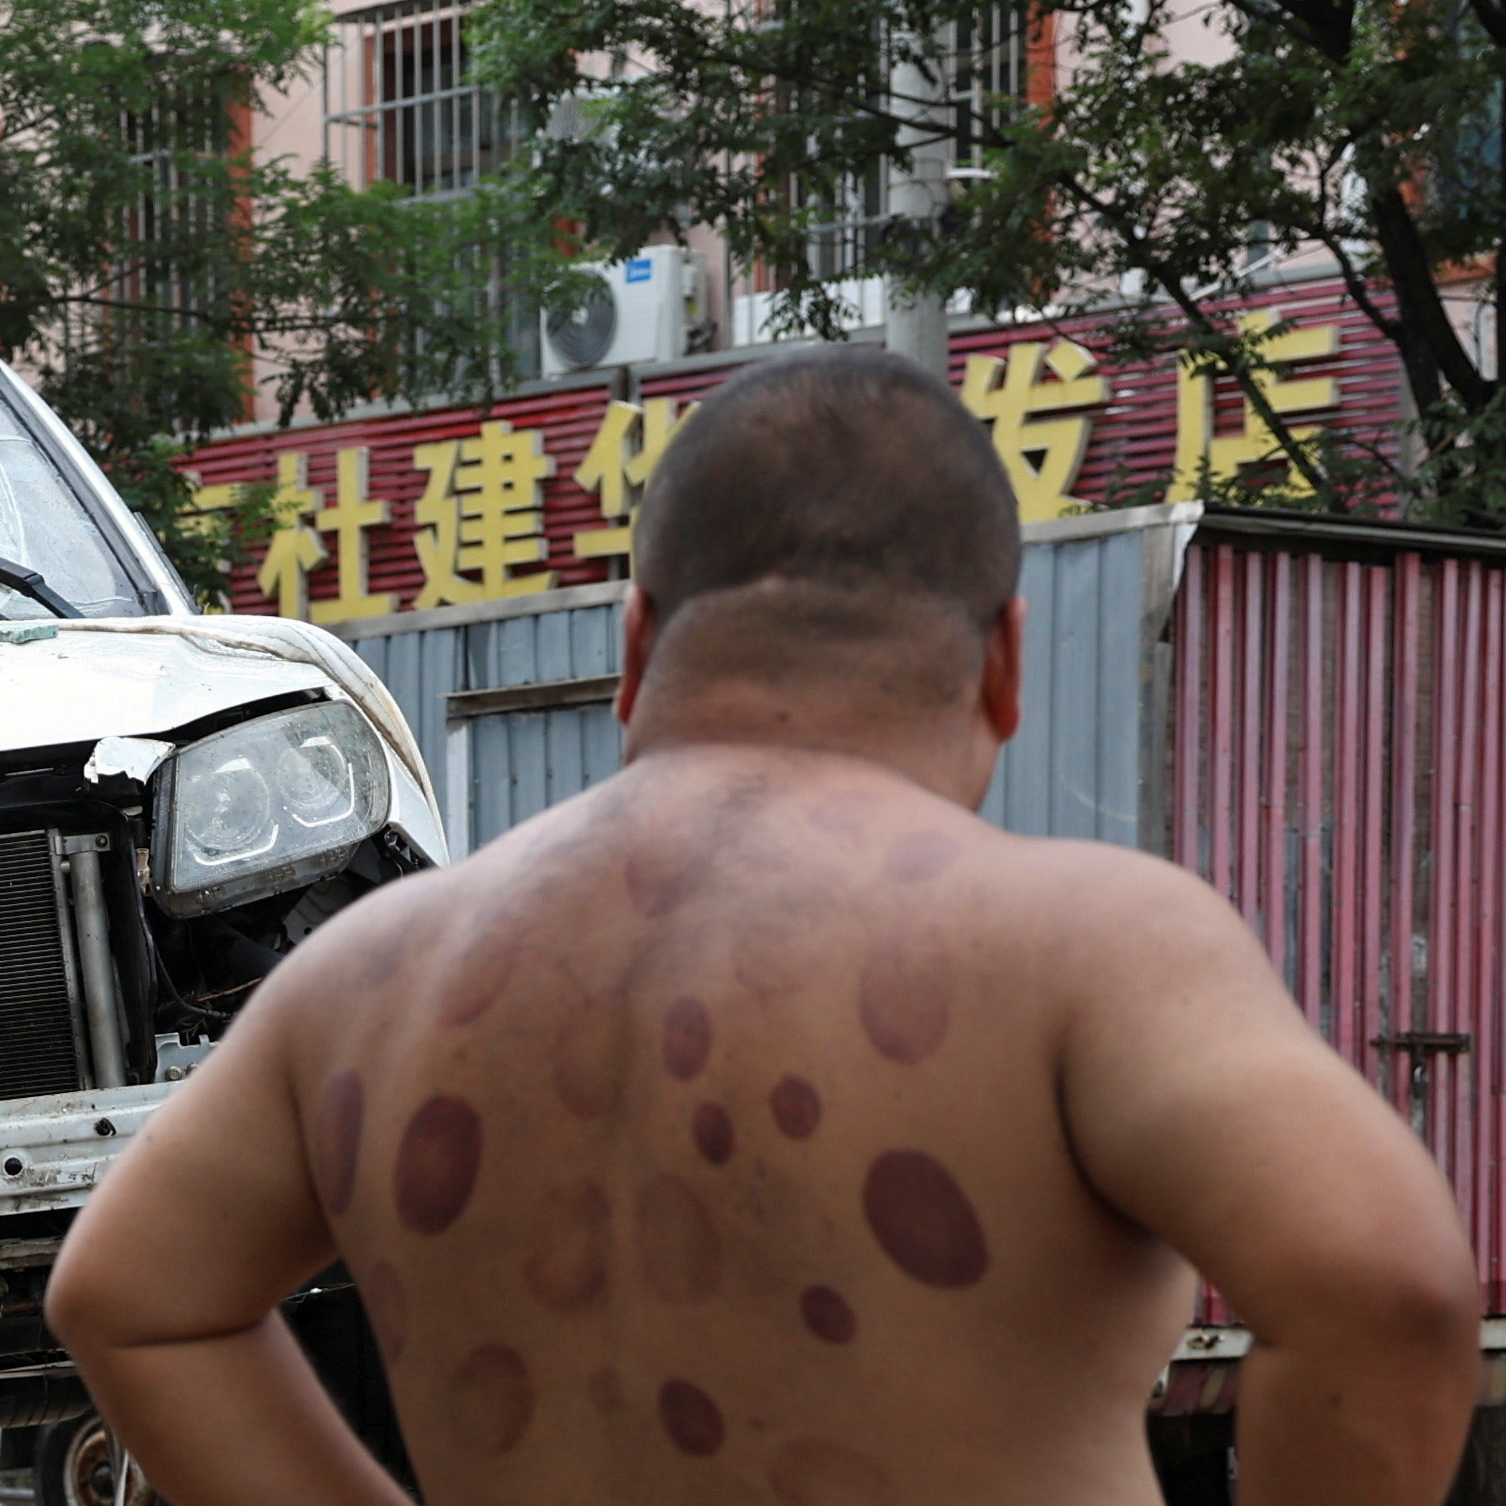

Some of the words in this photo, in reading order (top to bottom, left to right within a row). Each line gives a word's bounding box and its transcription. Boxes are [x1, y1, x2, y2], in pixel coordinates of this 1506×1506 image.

[179, 309, 1343, 622] 杜建华发店
